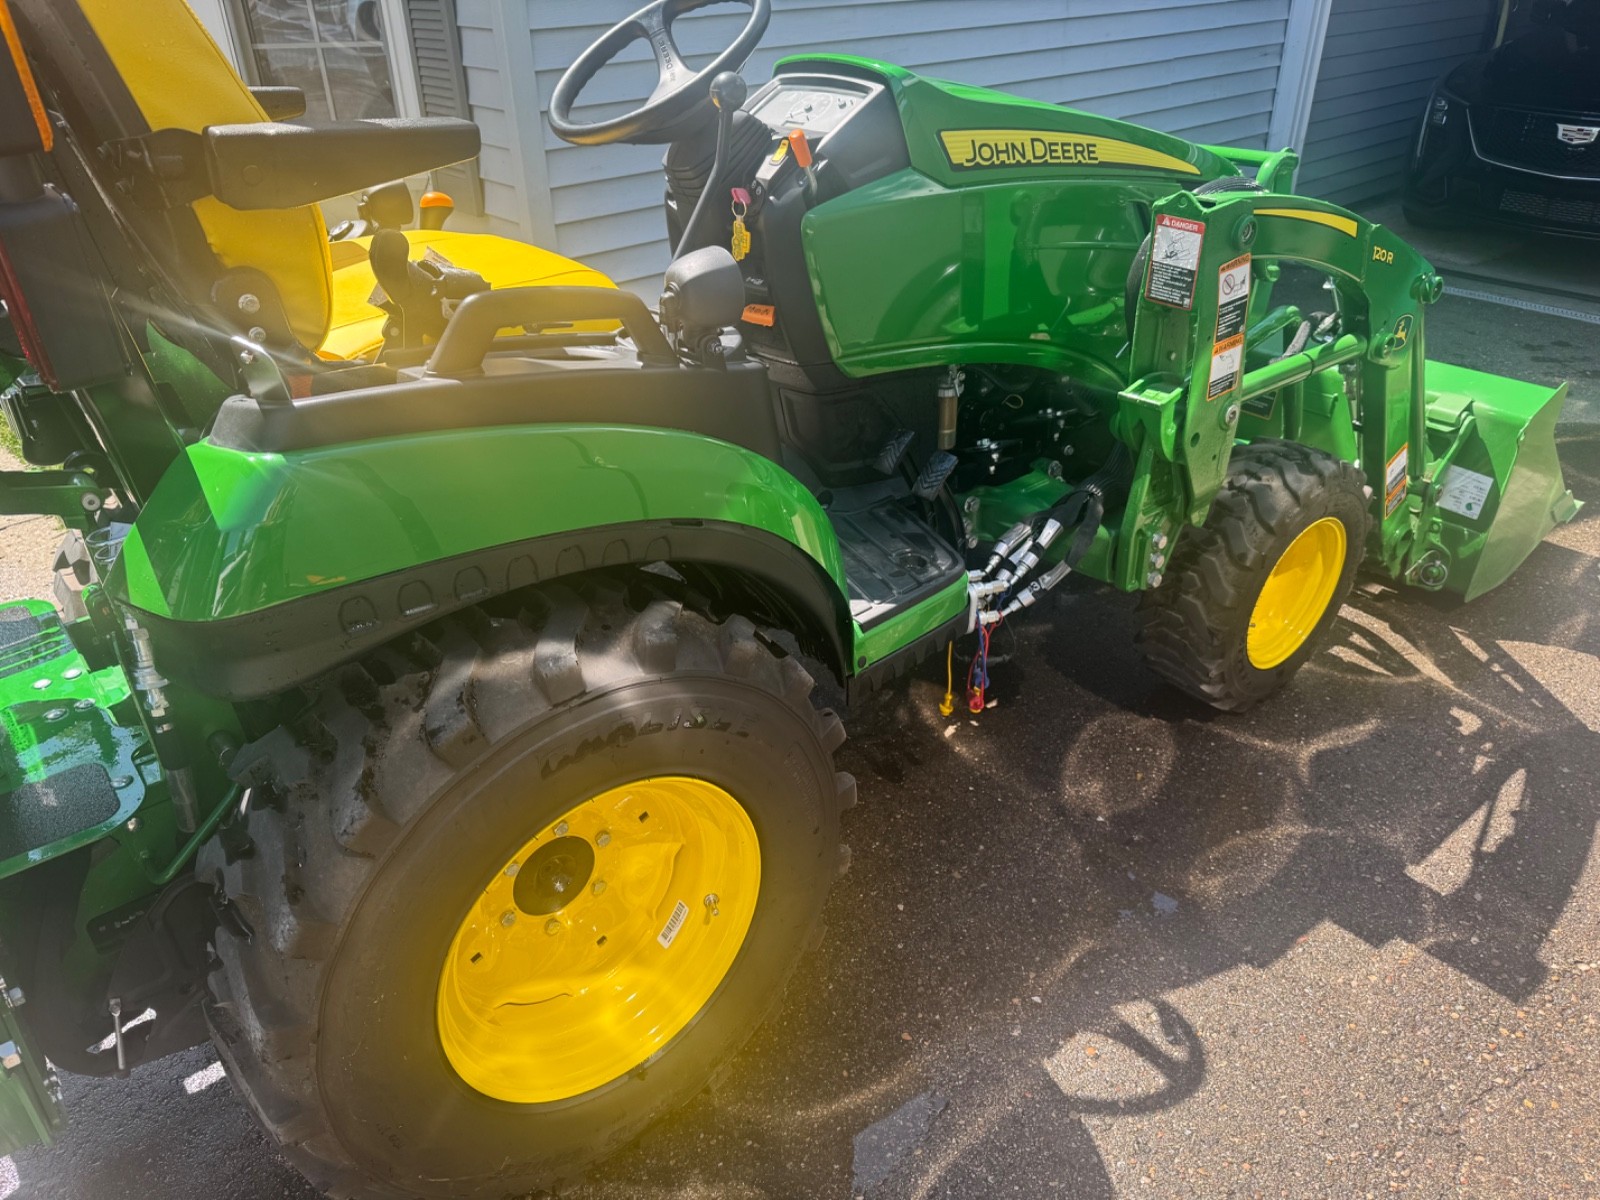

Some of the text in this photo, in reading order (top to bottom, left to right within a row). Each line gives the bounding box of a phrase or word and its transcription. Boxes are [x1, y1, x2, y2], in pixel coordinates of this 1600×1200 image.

[965, 137, 1099, 163] JOHN DEERE
[1171, 220, 1199, 232] DANGER
